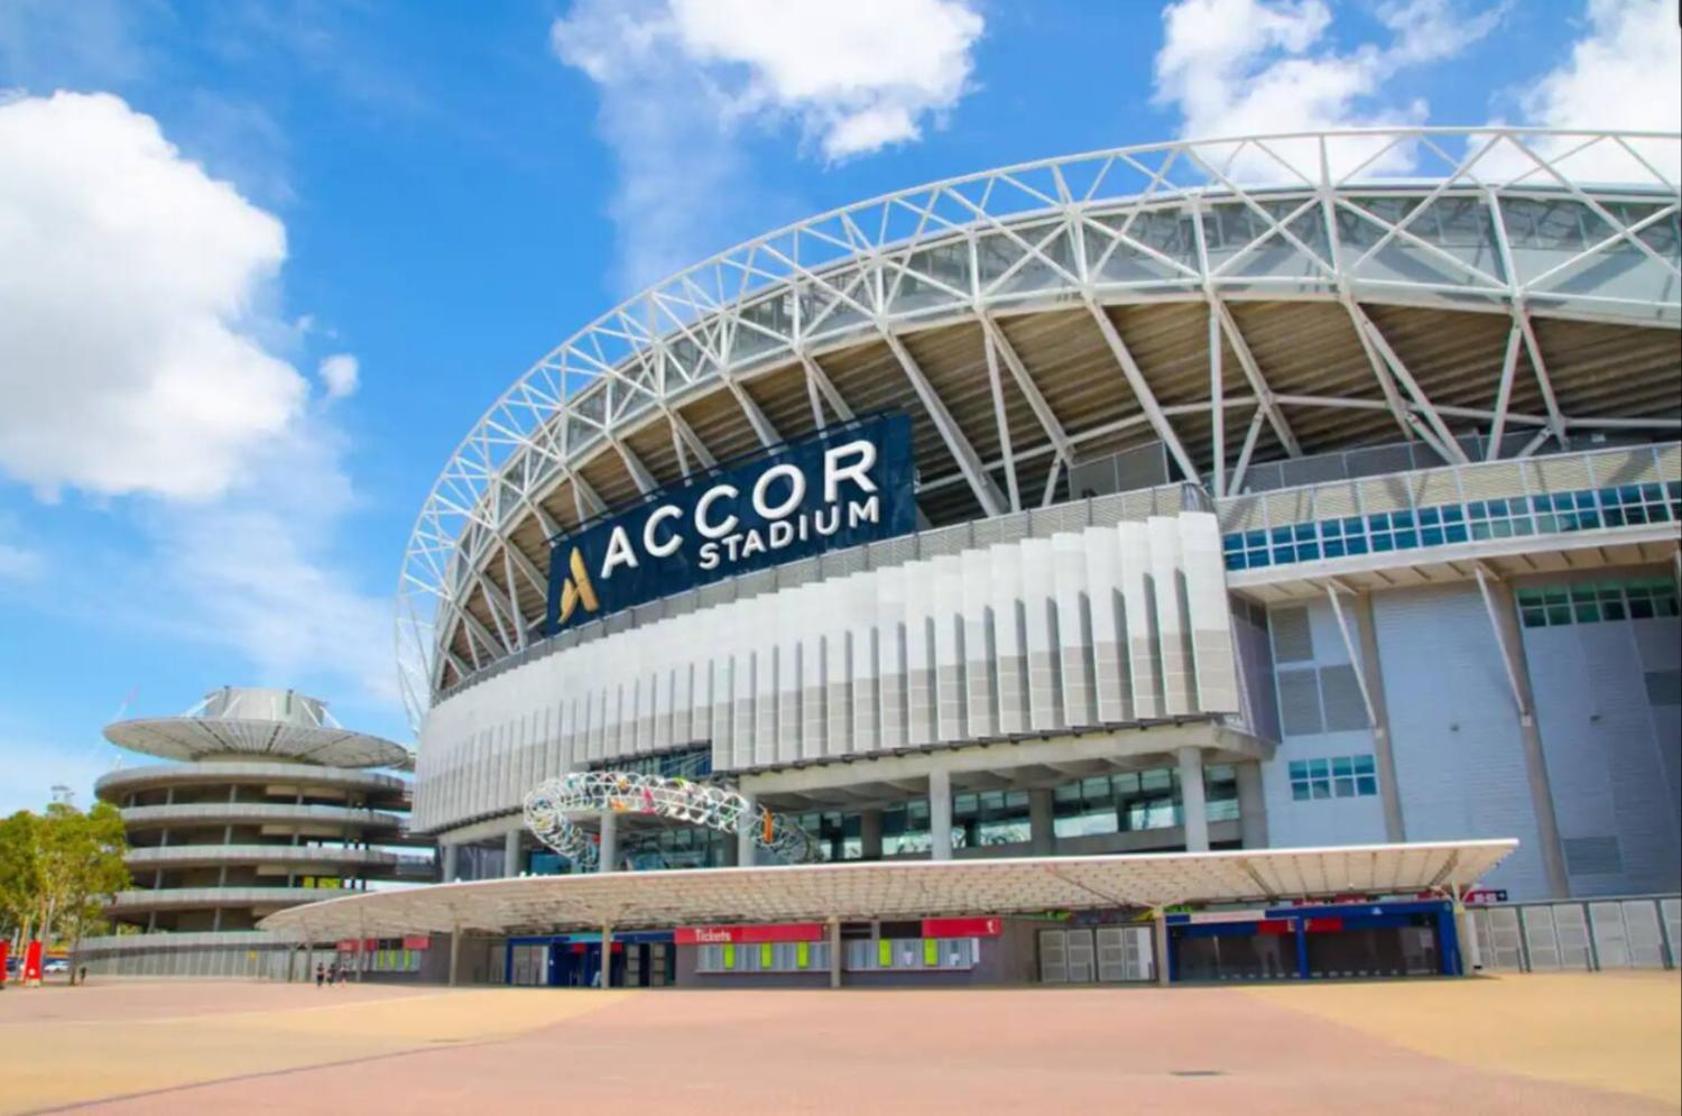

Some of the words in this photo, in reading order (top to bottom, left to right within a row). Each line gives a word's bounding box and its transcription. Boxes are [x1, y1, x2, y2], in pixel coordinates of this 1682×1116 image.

[601, 440, 878, 578] ACCOR
[699, 496, 879, 570] STADIUM
[695, 927, 731, 942] Tickets
